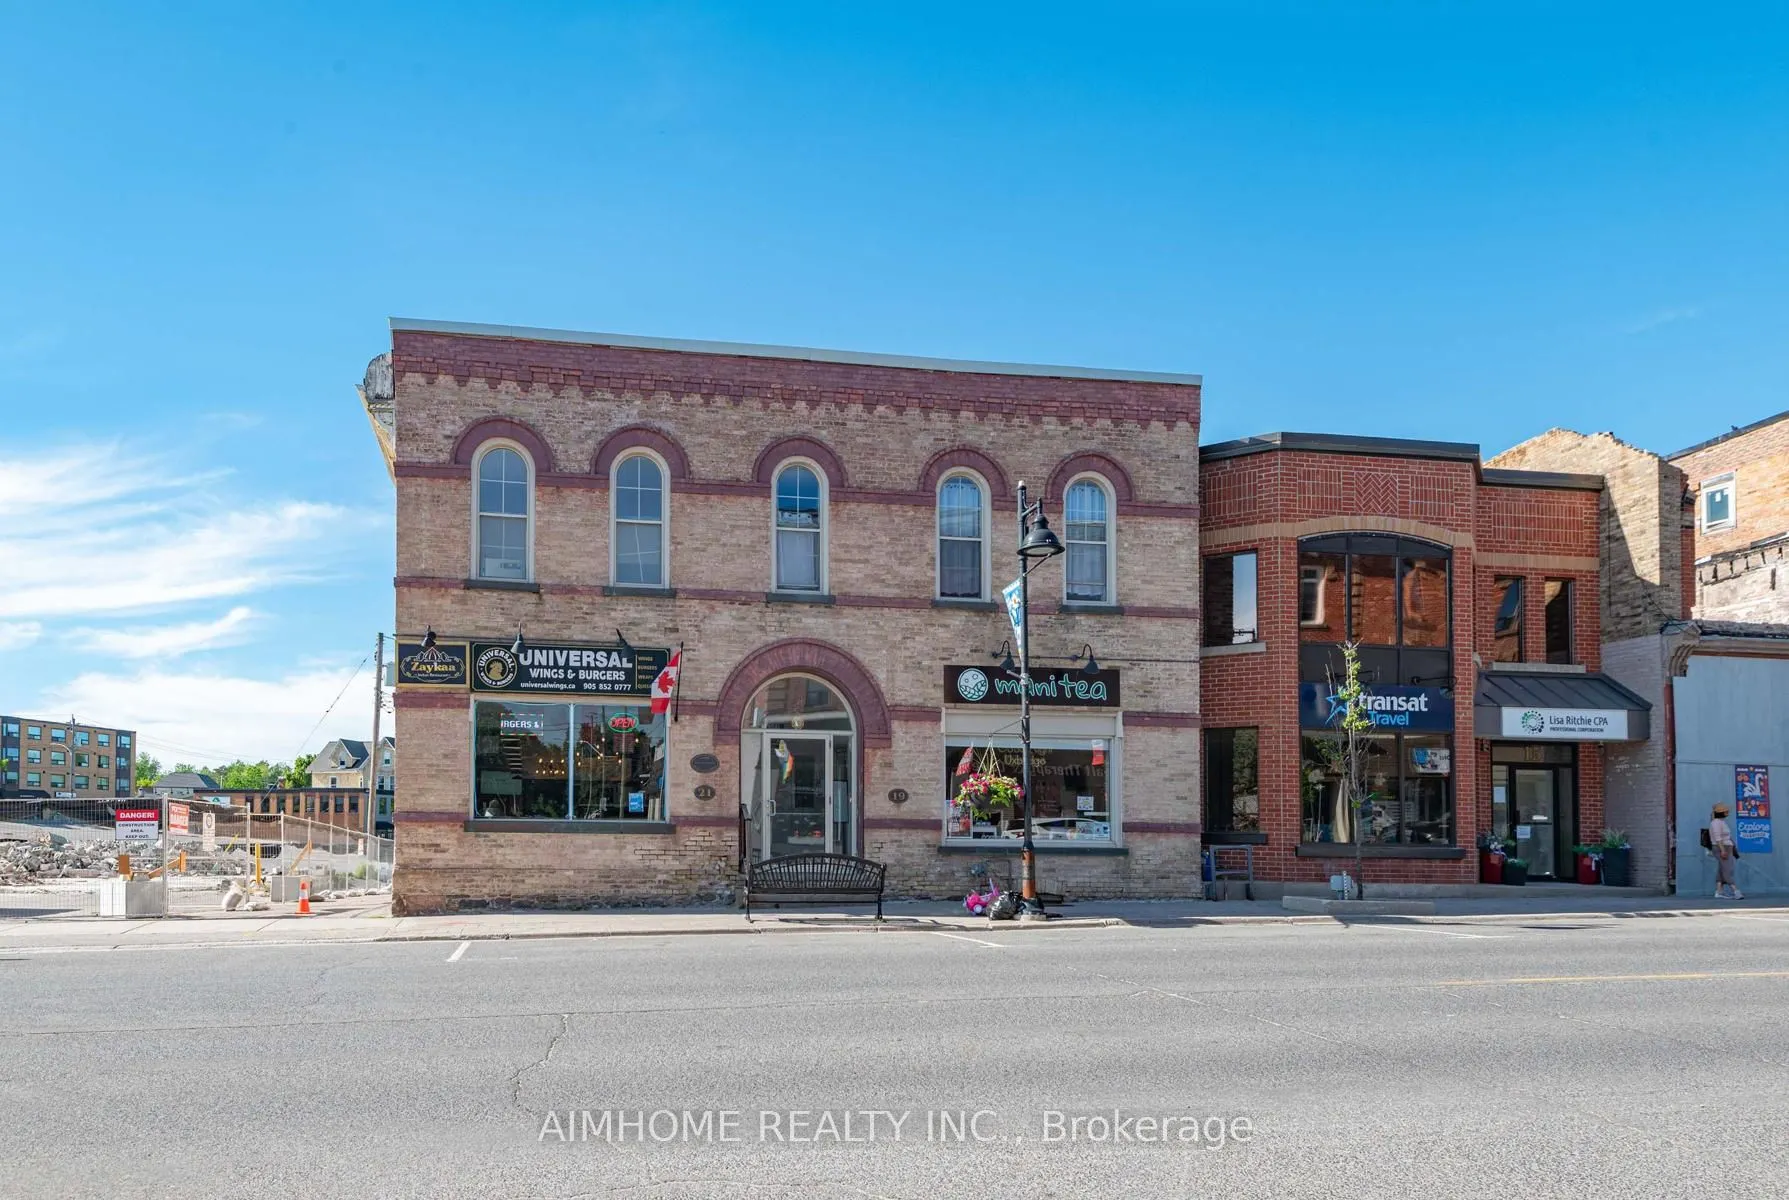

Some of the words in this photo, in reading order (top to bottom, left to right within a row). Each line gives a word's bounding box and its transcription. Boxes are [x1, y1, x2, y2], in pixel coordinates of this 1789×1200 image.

[479, 649, 515, 668] UNIVERSAL
[519, 649, 633, 668] UNIVERSAL
[411, 661, 456, 673] Zaykaa
[529, 668, 565, 679] WINGS
[567, 669, 576, 679] &
[578, 669, 626, 681] BURGERS
[520, 681, 576, 690] universalwings.ca
[583, 682, 597, 690] 905
[1358, 692, 1428, 711] transat
[609, 717, 636, 729] OPEN
[1367, 711, 1409, 725] Travel
[1549, 715, 1564, 725] Lisa
[1566, 715, 1592, 726] Ritchie
[1593, 717, 1608, 726] CPA
[699, 788, 711, 797] 21
[892, 791, 905, 800] 19
[1738, 821, 1770, 832] Explore
